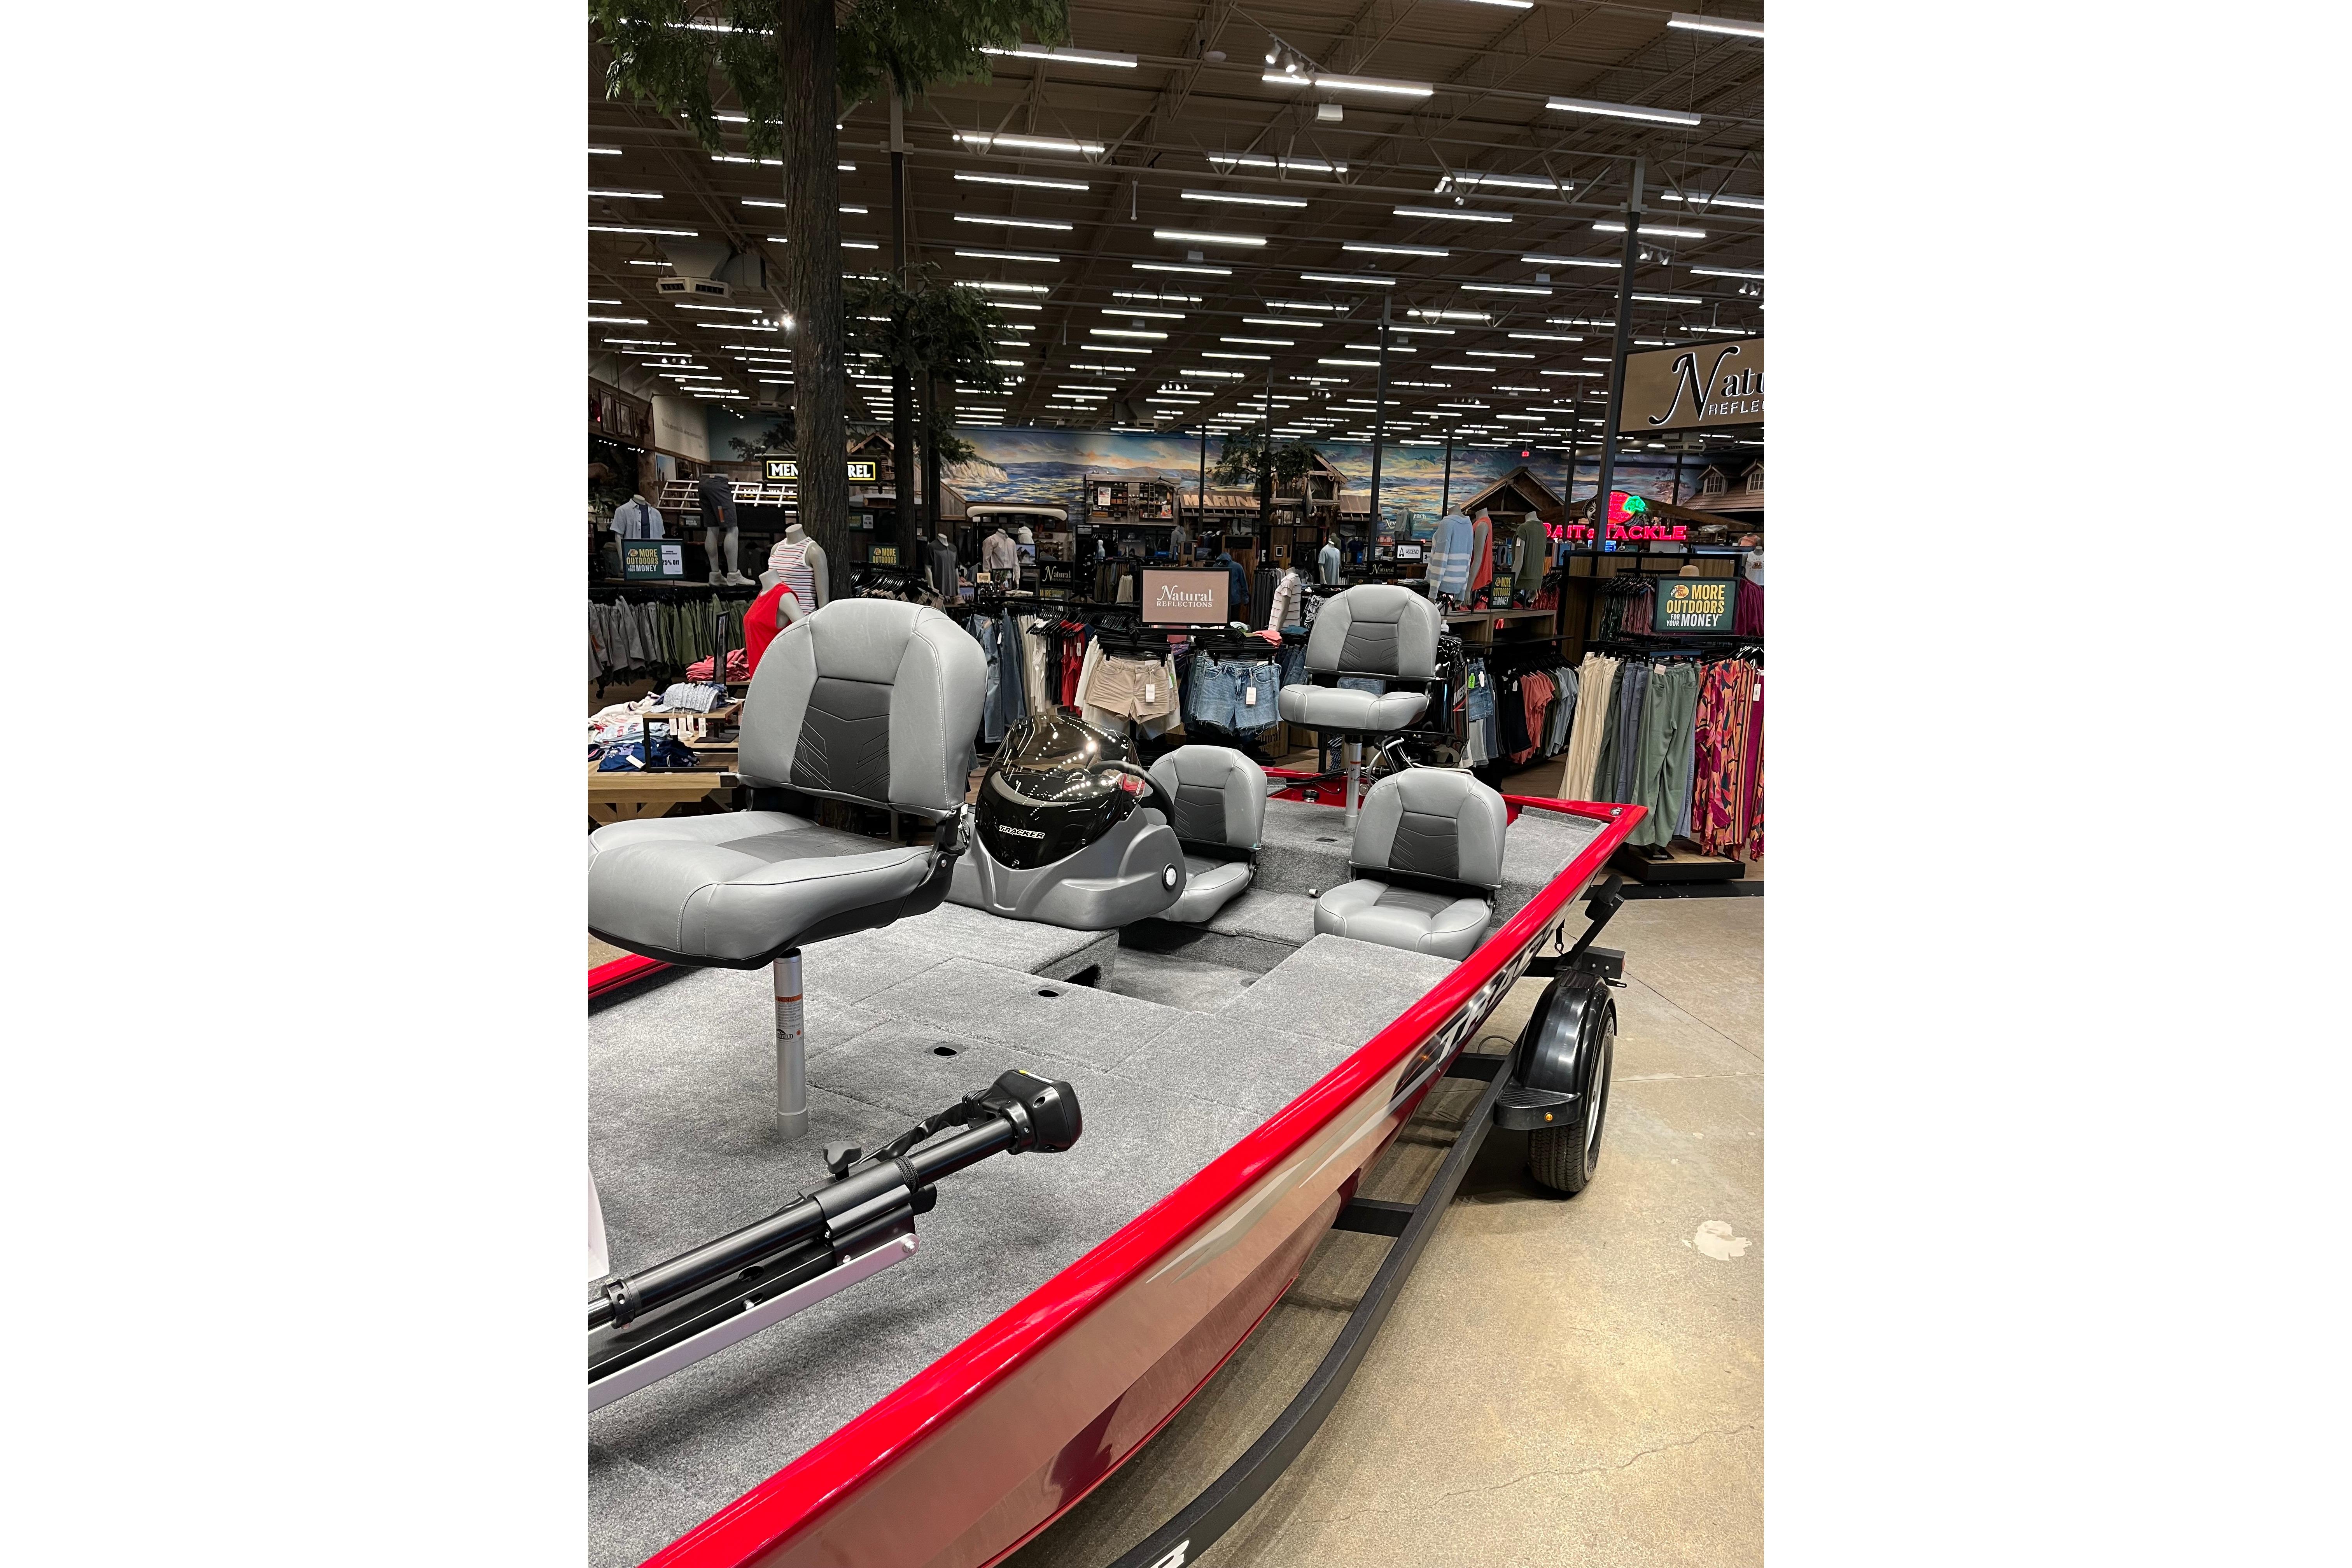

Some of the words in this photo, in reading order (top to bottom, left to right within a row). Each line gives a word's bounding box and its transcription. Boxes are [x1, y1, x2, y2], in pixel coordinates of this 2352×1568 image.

[1708, 400, 1764, 415] REFLE
[847, 465, 871, 478] REL
[1605, 523, 1687, 540] TACKLE
[639, 549, 658, 557] MORE
[882, 548, 896, 556] MORE
[1042, 566, 1071, 582] Natural
[1369, 564, 1395, 575] Natural
[1501, 577, 1511, 588] MORE
[1157, 585, 1214, 602] Natural
[1493, 587, 1511, 597] OUTDOORS
[1692, 584, 1726, 600] MORE
[1496, 596, 1510, 605] MONEY
[1666, 600, 1725, 614] OUTDOORS
[1680, 613, 1720, 627] MONEY
[999, 825, 1045, 839] TRACKER
